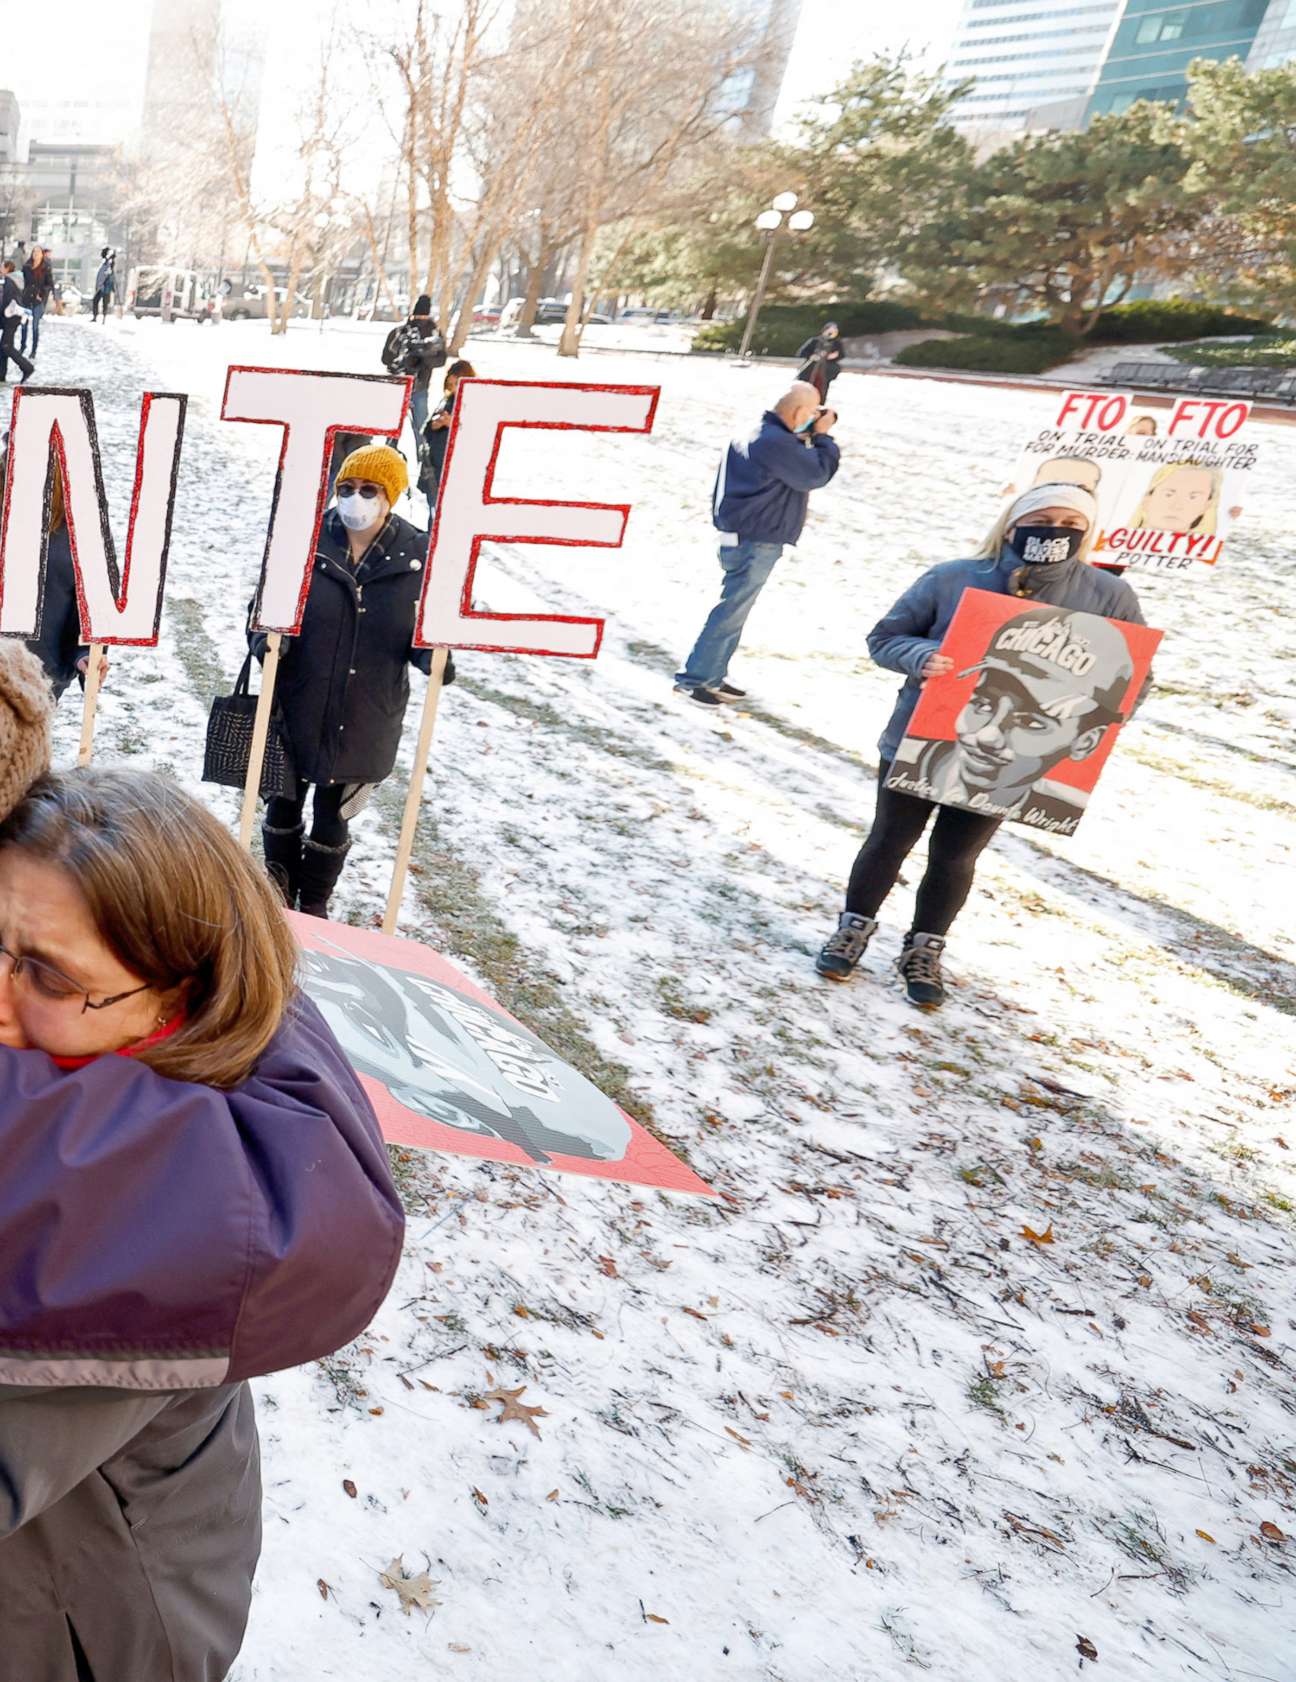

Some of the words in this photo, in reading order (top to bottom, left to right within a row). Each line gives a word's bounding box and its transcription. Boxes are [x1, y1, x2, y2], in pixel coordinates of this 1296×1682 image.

[1056, 393, 1127, 431] FTO
[1168, 401, 1250, 439] FTO
[1024, 441, 1055, 454] FOR
[1056, 444, 1130, 459] MURDER
[1038, 430, 1065, 442] ON
[1074, 432, 1126, 447] TRIAL
[1144, 438, 1166, 449] ON
[1173, 439, 1218, 454] TRIAL
[1225, 443, 1259, 456] FOR
[1136, 449, 1257, 470] MANSLAUGHTER
[1108, 527, 1217, 557] GUILTY!
[1115, 551, 1193, 570] POTTER
[995, 620, 1097, 677] CHICAGO
[1023, 806, 1080, 833] Wright
